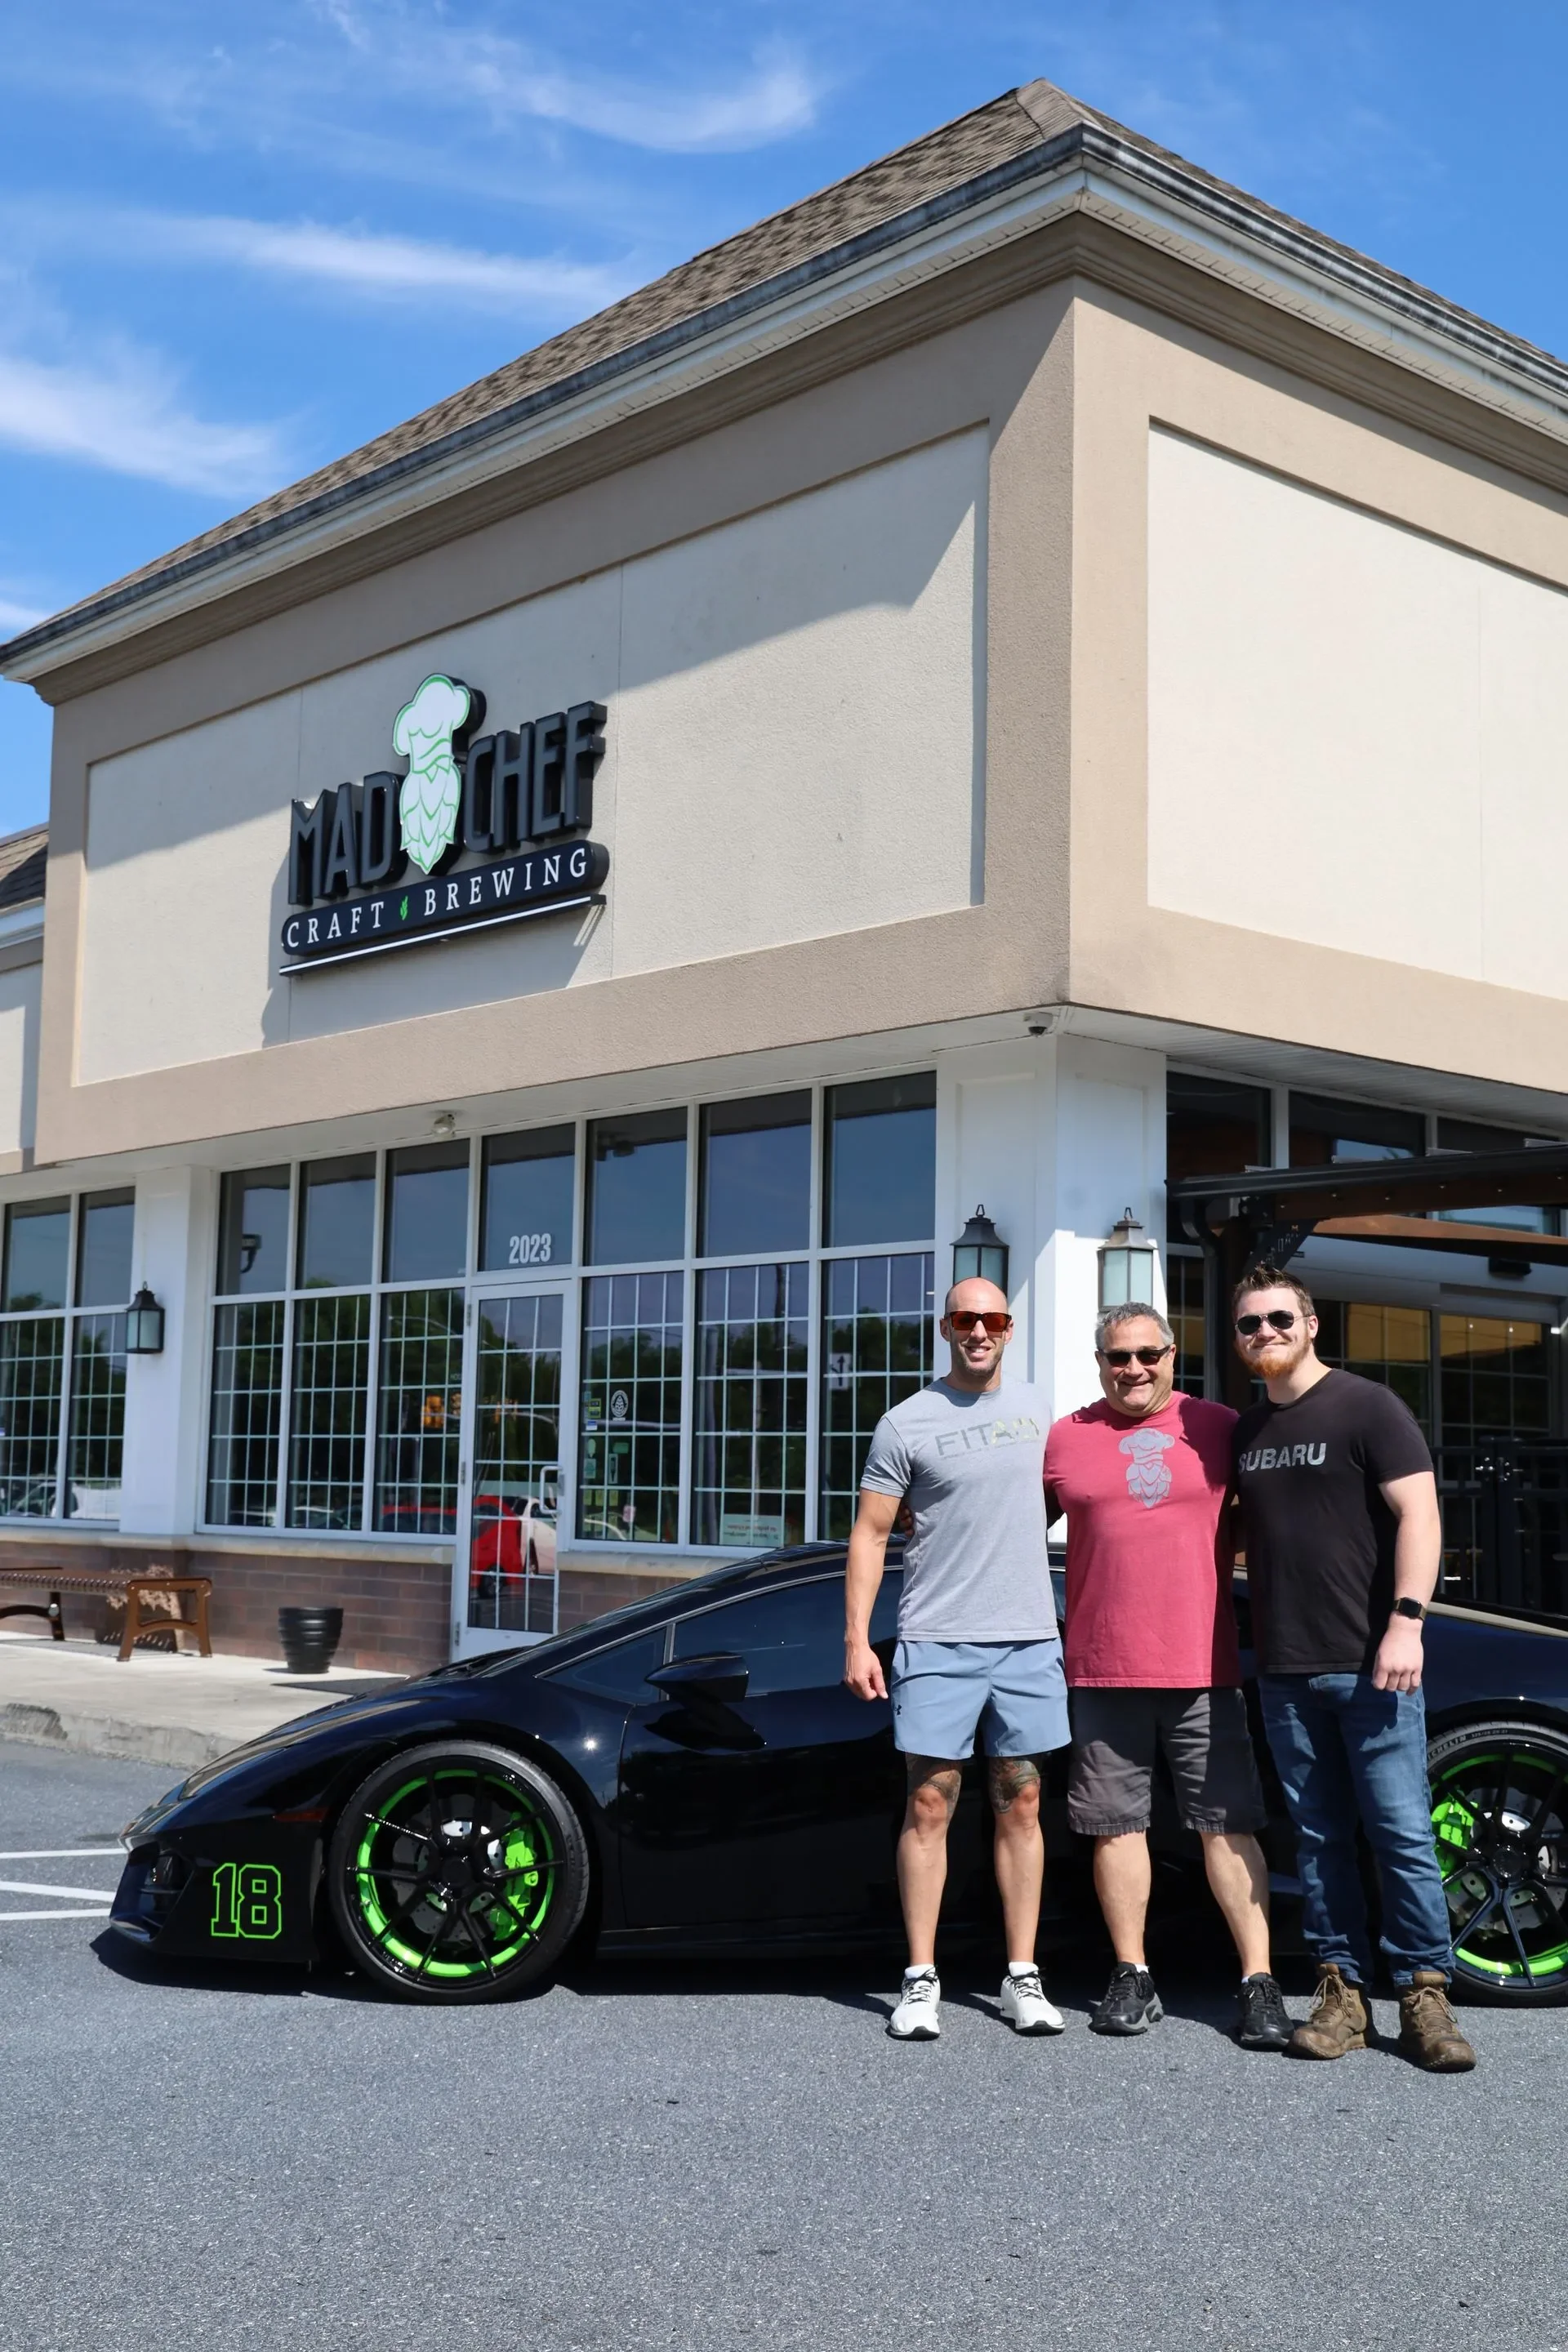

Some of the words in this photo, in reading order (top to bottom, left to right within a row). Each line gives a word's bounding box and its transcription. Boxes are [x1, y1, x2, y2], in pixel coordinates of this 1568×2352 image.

[287, 771, 404, 906] MAD
[463, 701, 607, 854] CHEF
[287, 902, 384, 947] CRAFT
[424, 848, 588, 916] BREWING
[509, 1233, 551, 1263] 2023
[1238, 1443, 1326, 1473] SUBARU
[1427, 1735, 1467, 1760] ICHELIN
[212, 1863, 282, 1939] 18
